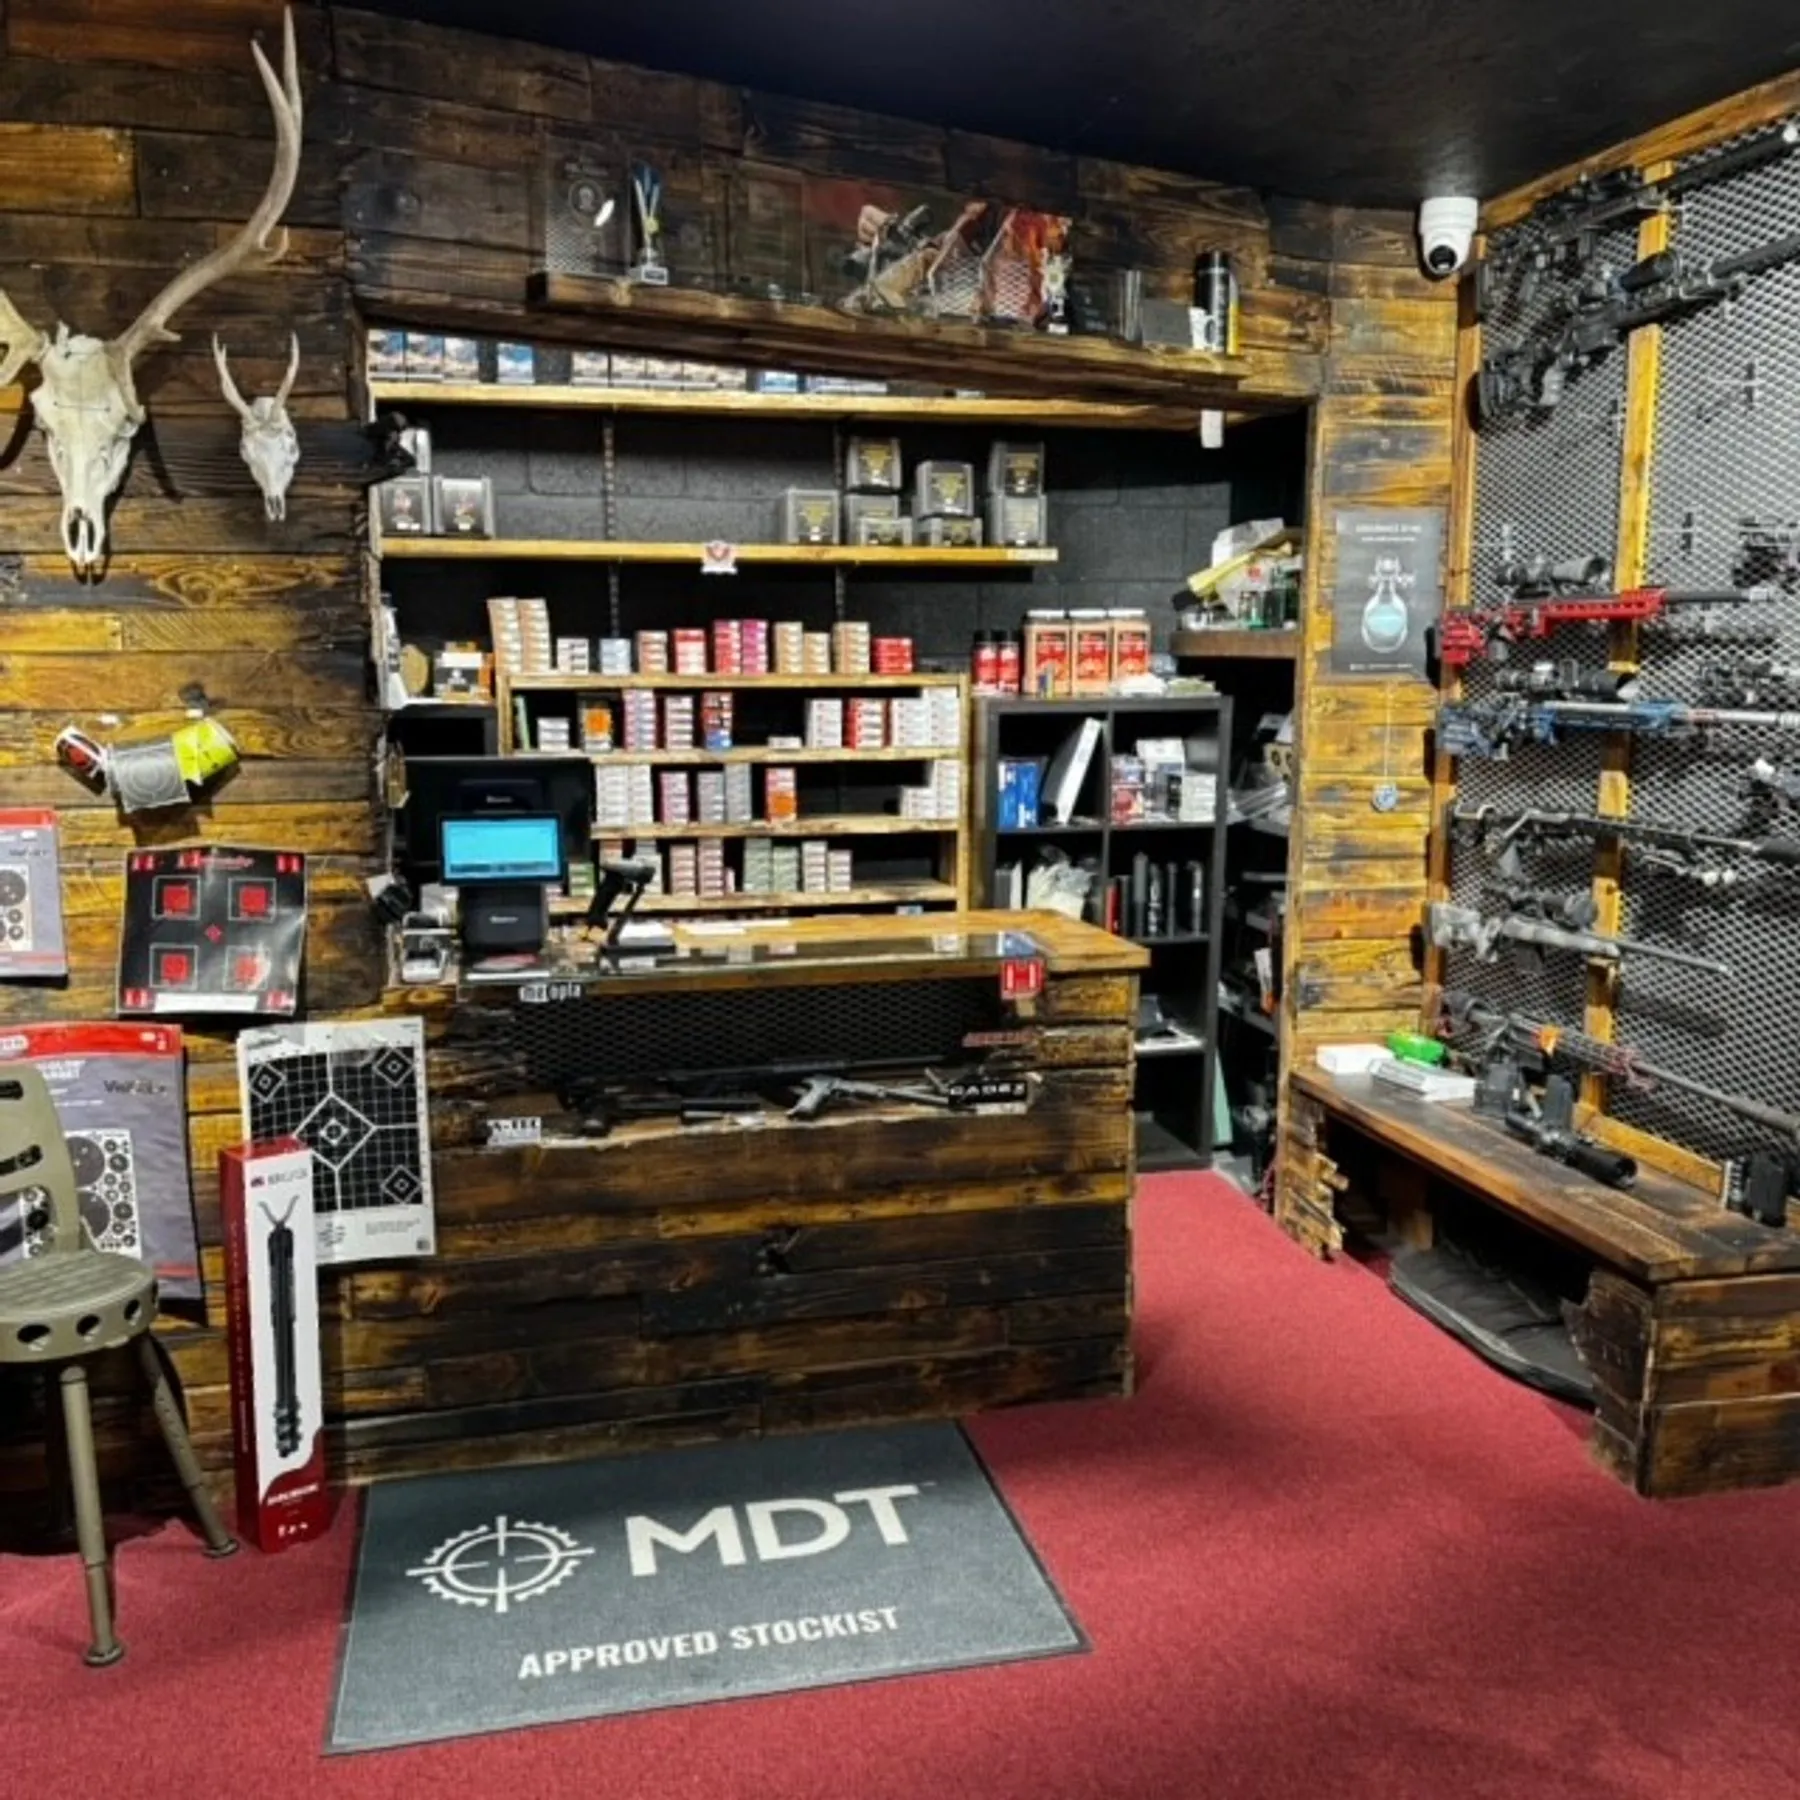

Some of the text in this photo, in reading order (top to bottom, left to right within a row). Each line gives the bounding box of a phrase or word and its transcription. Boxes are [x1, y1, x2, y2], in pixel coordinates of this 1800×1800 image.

[625, 1484, 919, 1576] MDT
[517, 1606, 900, 1680] APPROVED STOCKIST
